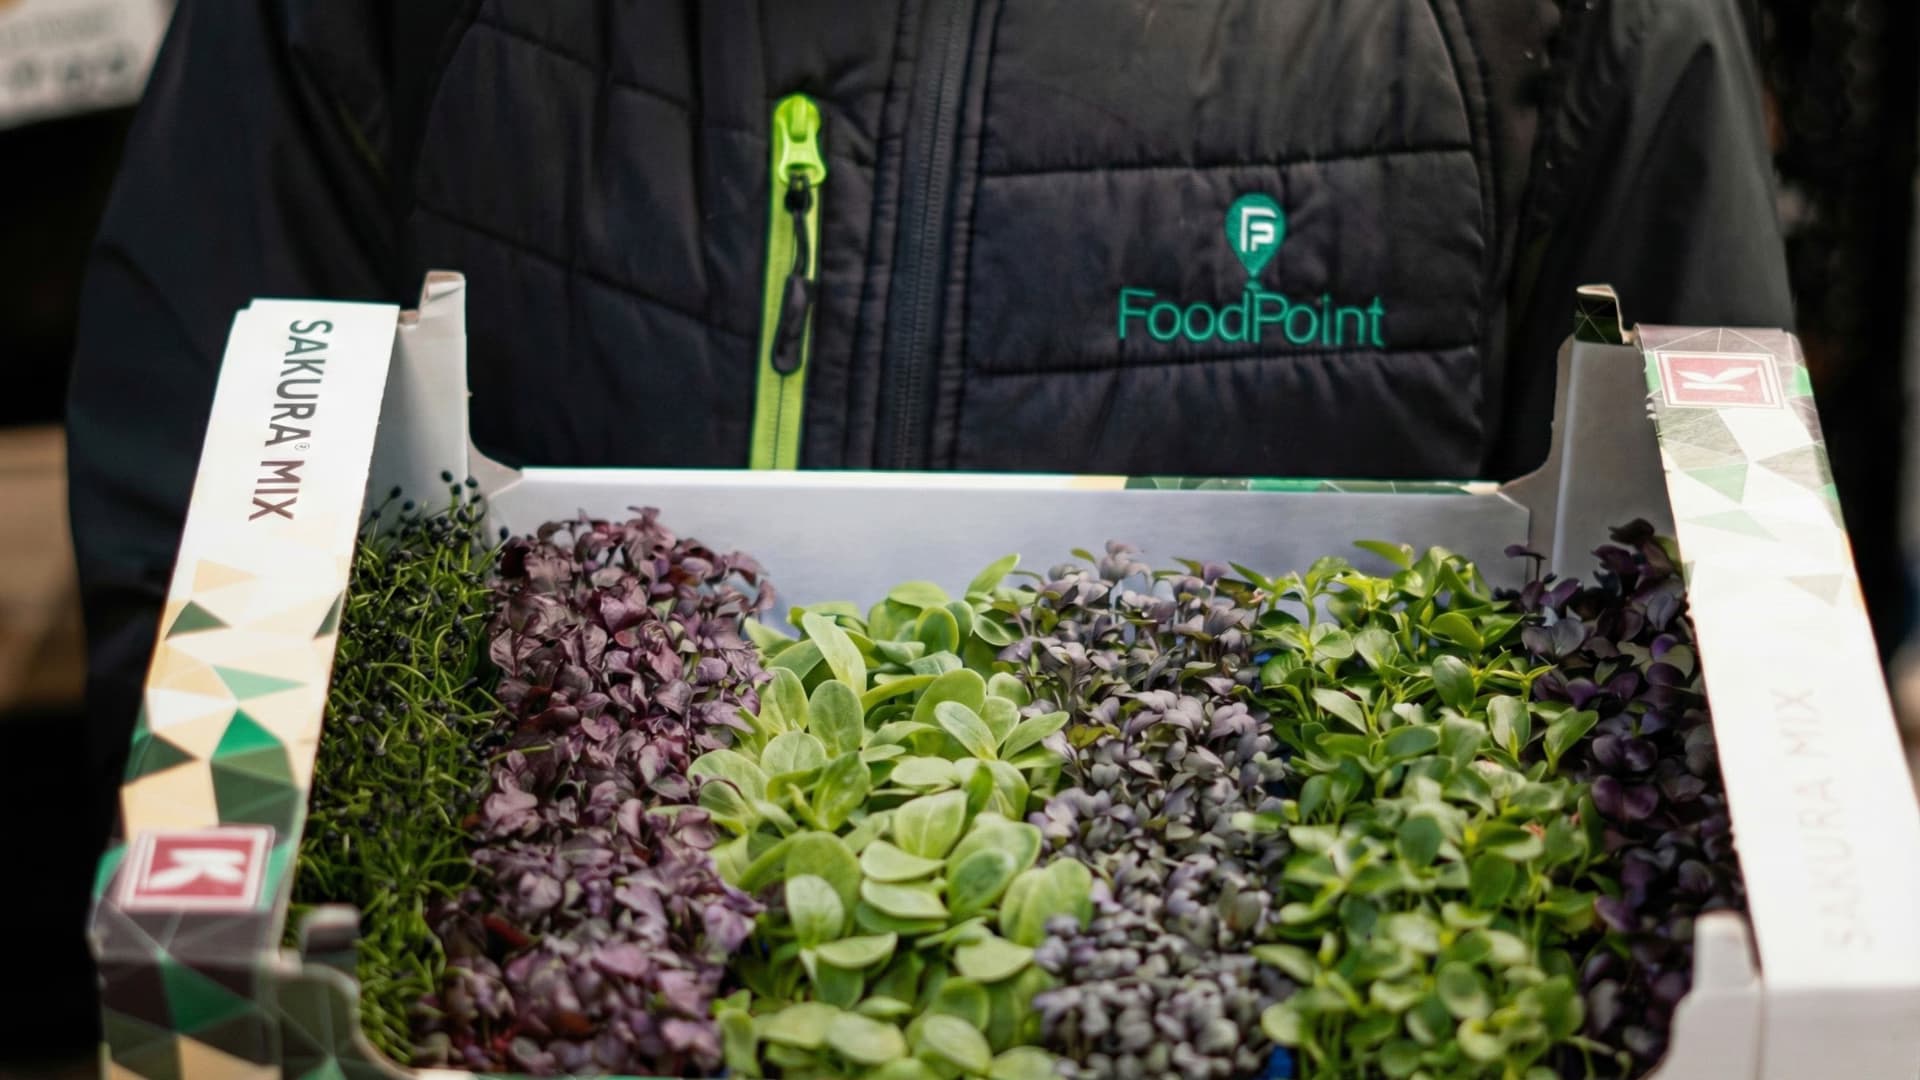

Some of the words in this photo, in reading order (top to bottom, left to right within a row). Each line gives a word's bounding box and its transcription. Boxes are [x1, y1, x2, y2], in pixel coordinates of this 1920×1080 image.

[1117, 286, 1385, 347] FoodPoint
[248, 460, 305, 521] MIX
[1769, 688, 1832, 759] MIX
[143, 848, 246, 891] K
[1792, 775, 1874, 951] SAKURA
